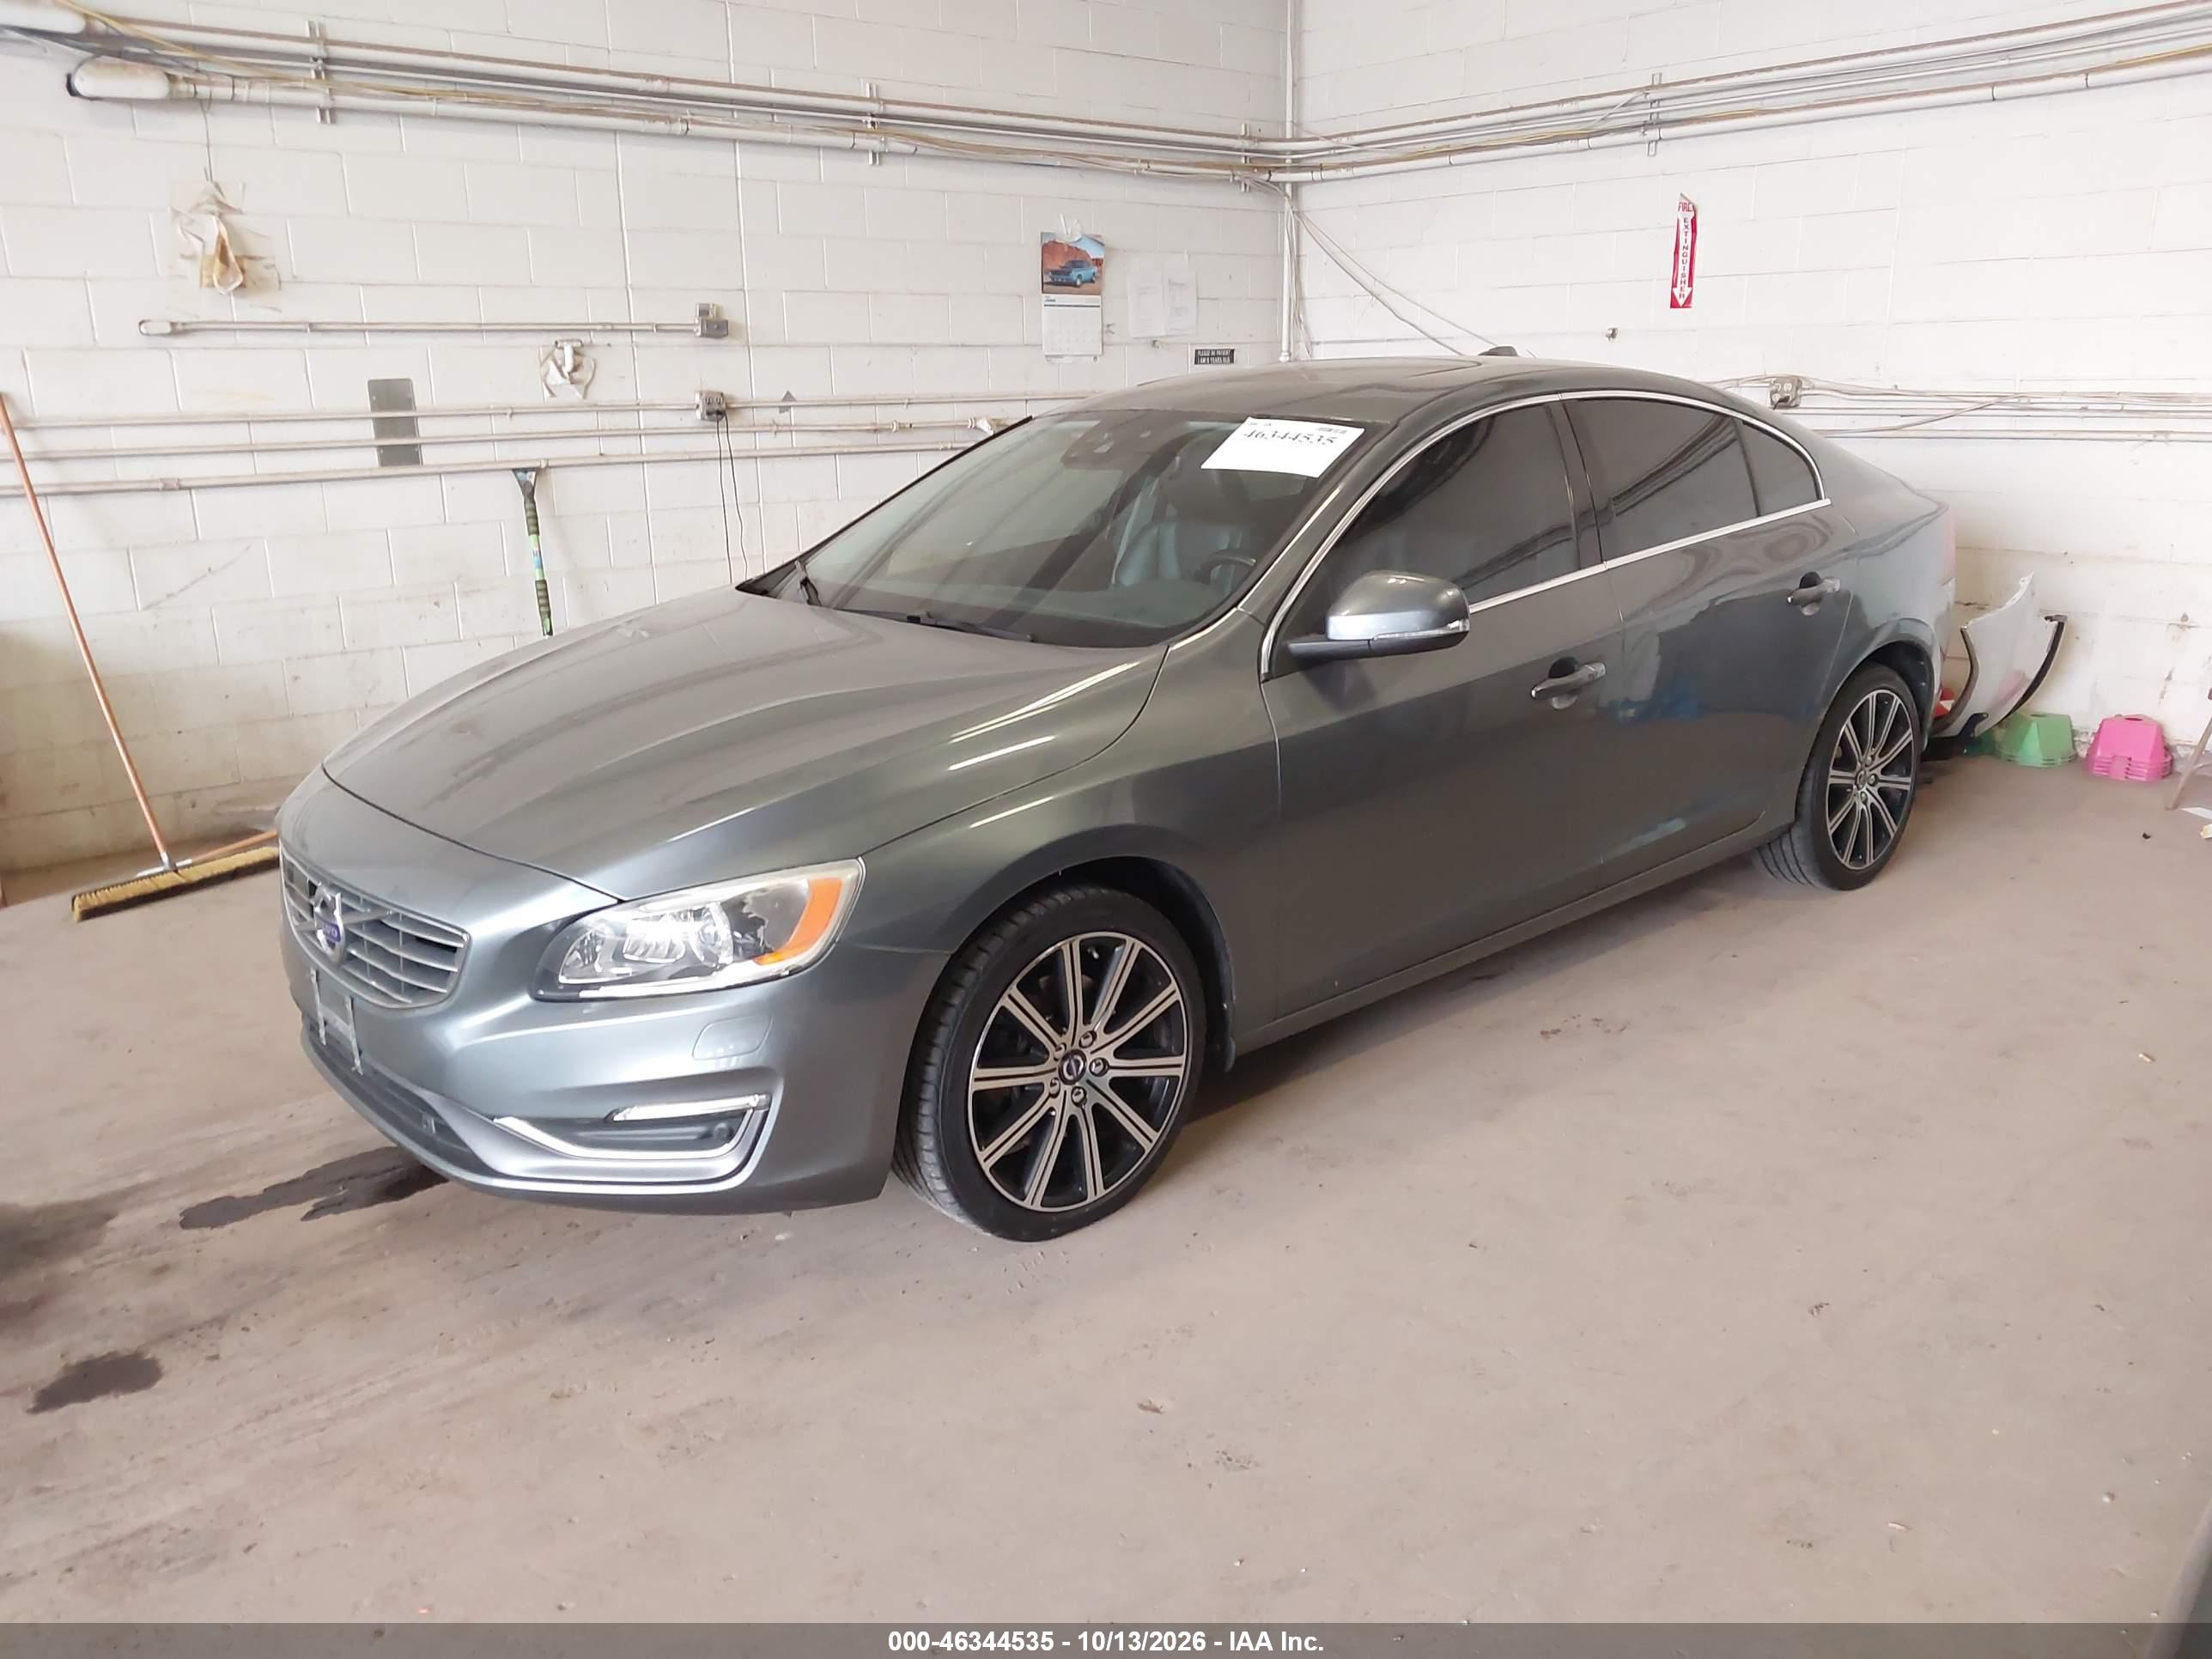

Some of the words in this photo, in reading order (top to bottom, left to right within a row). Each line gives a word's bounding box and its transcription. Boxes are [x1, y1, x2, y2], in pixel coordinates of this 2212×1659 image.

[1678, 202, 1692, 212] FIRE
[1679, 217, 1689, 299] EXTINGUISHER
[1243, 429, 1338, 446] 46344535
